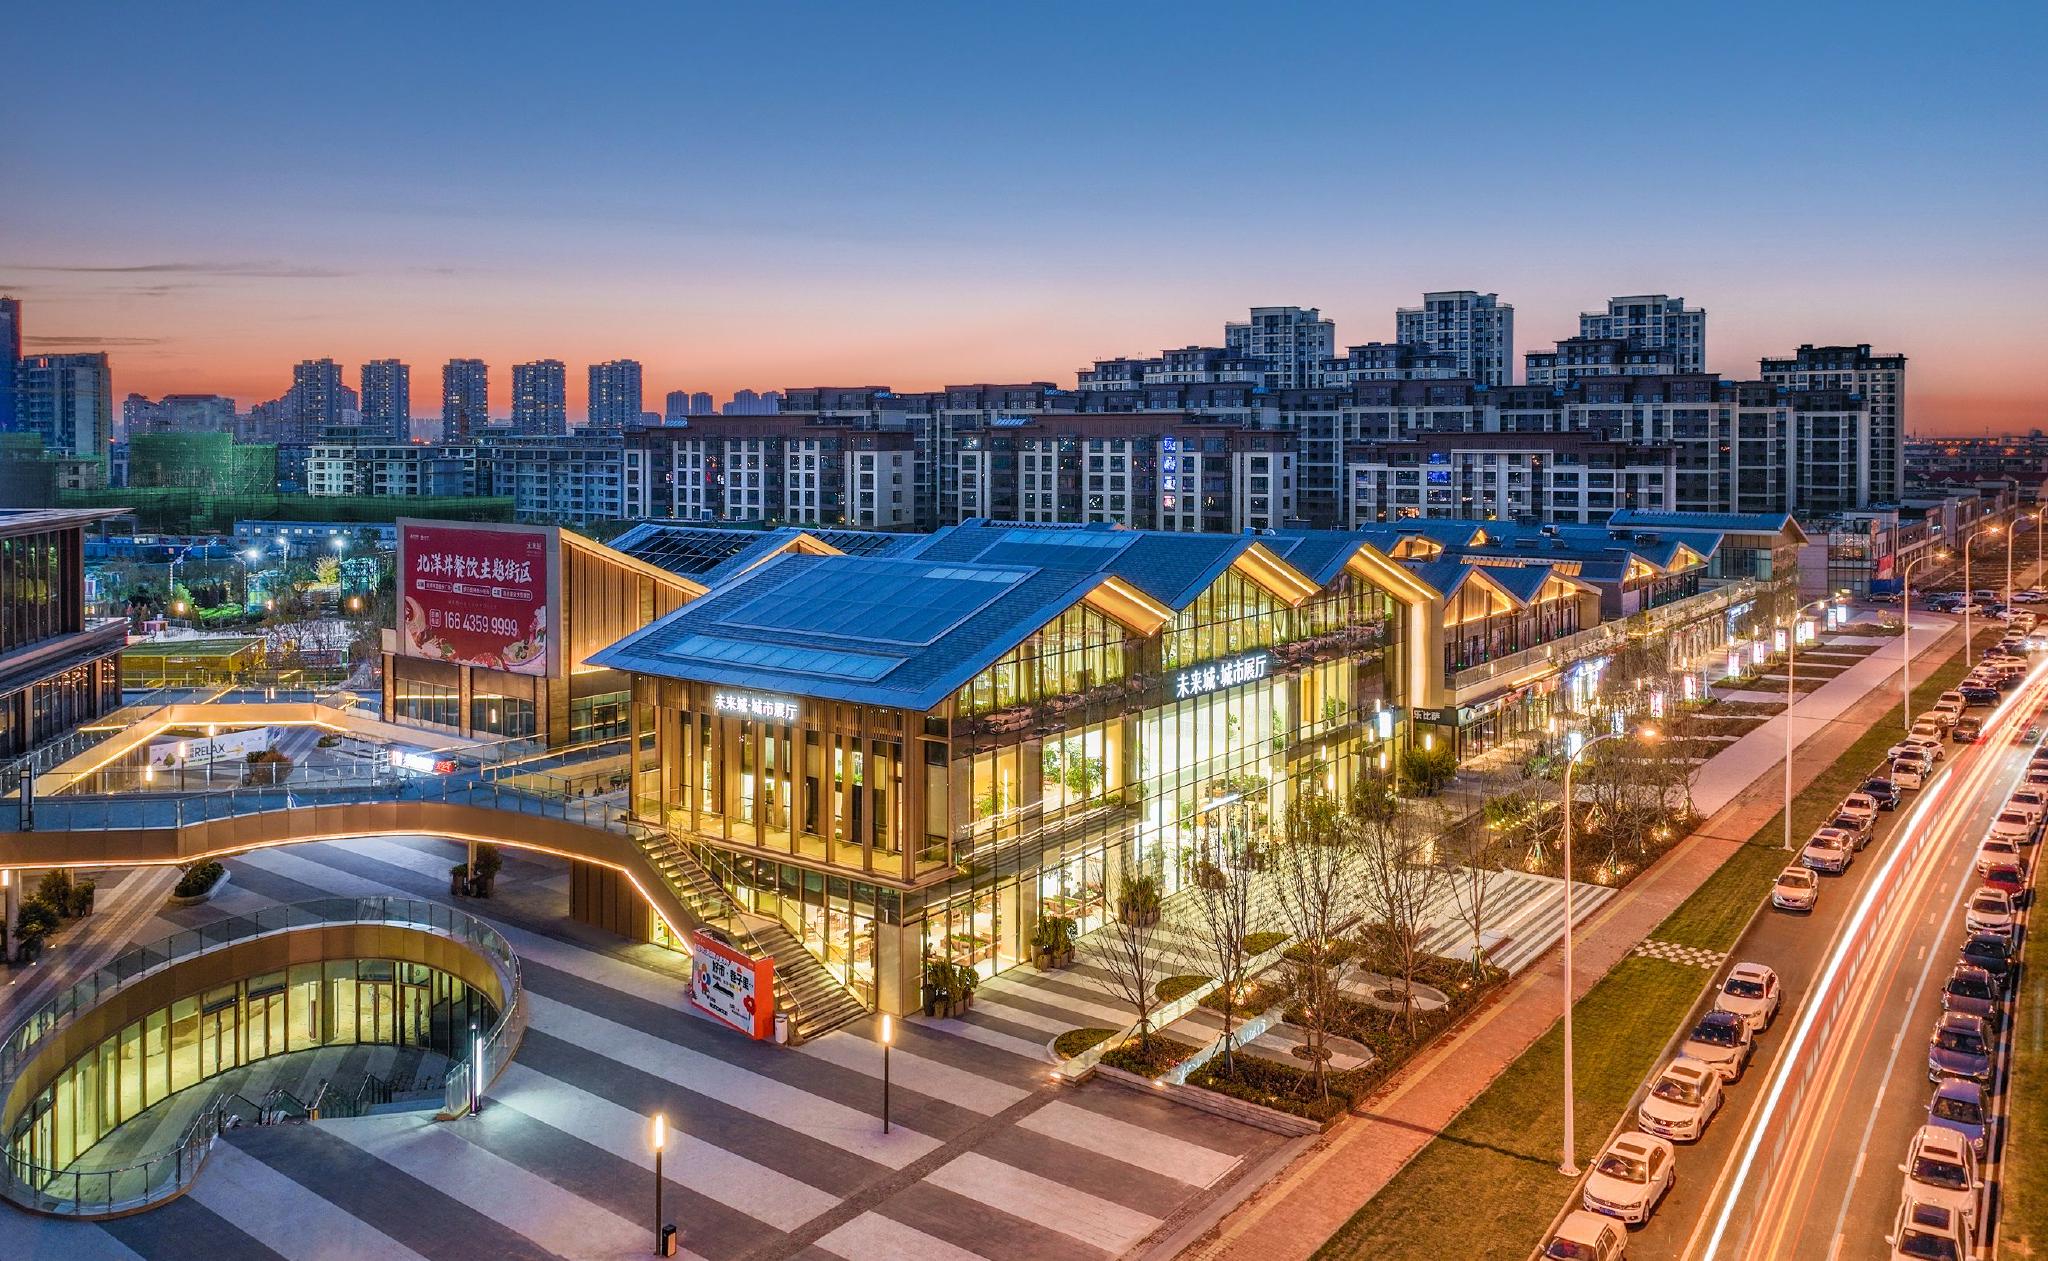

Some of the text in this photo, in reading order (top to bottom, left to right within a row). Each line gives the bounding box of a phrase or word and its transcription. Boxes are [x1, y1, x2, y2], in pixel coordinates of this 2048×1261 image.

[444, 611, 460, 629] 166
[463, 614, 489, 633] 4359
[491, 617, 518, 637] 9999
[1176, 655, 1267, 698] 未来城·城市展厅
[194, 743, 226, 758] RELAX
